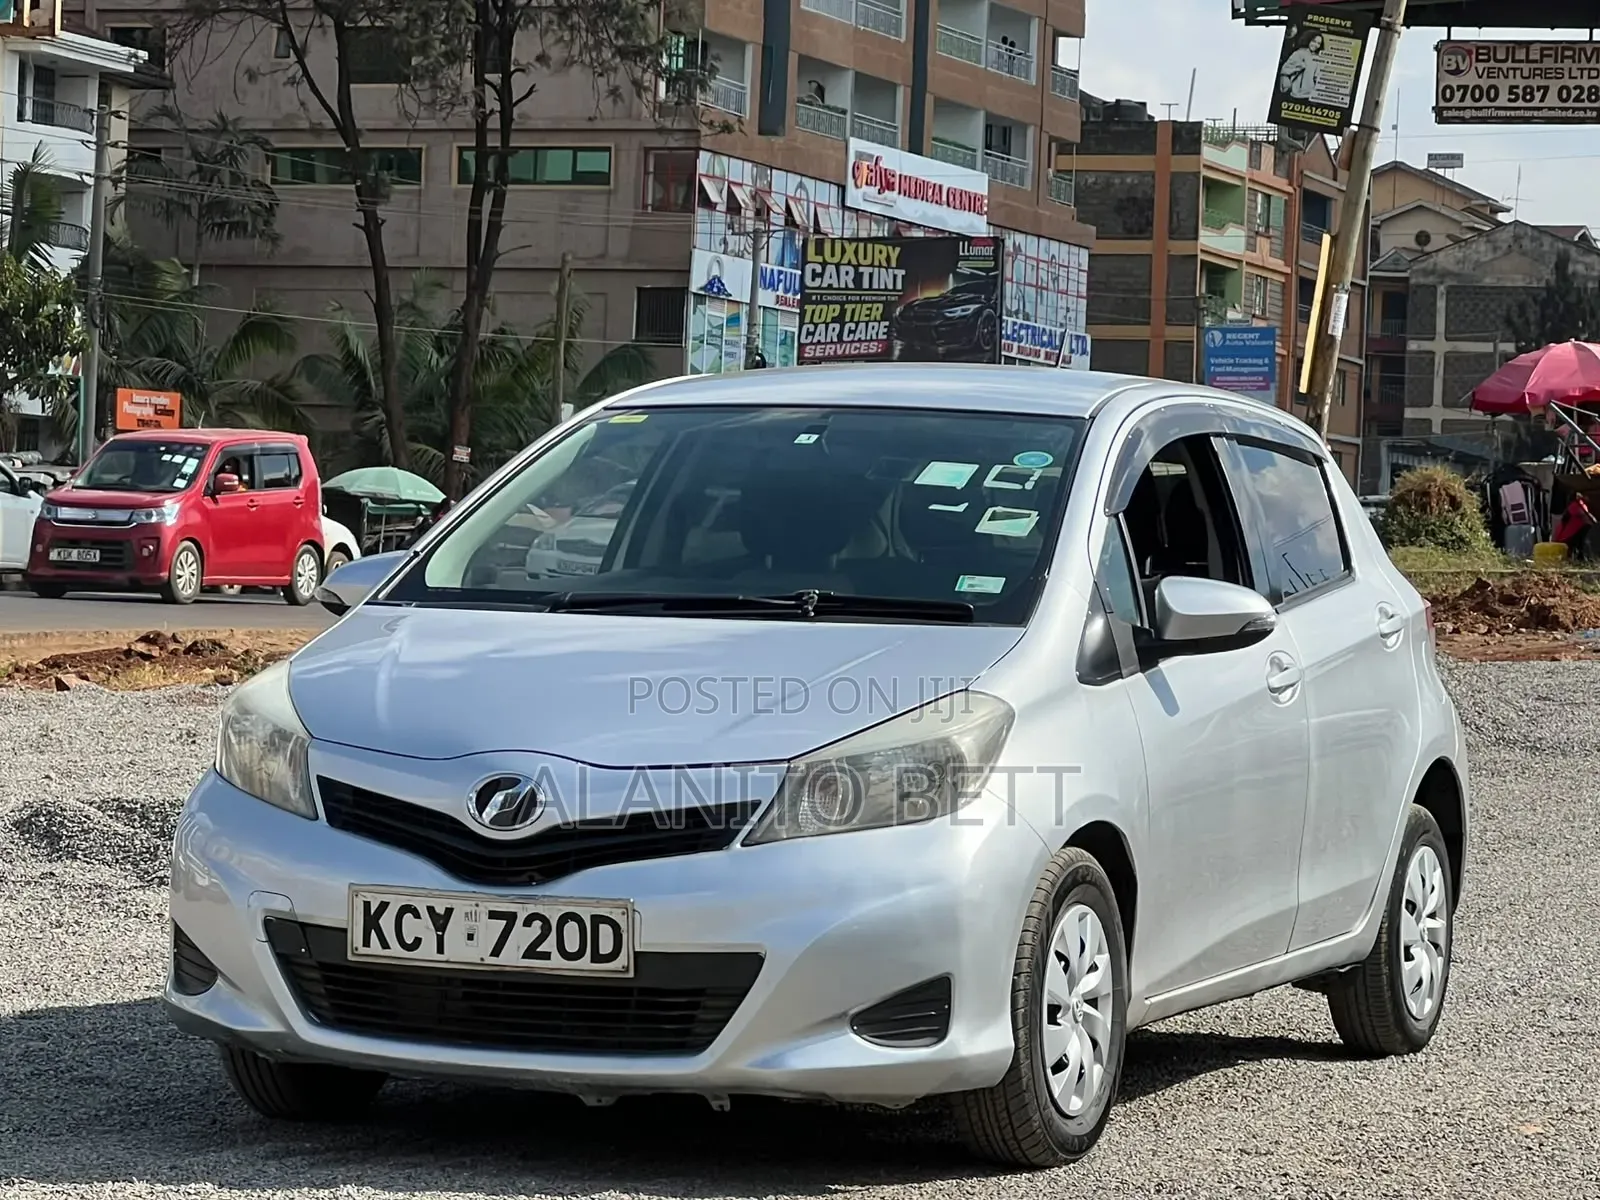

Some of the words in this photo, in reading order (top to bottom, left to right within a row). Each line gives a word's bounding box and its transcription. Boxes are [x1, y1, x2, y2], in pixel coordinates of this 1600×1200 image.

[1307, 14, 1352, 27] PROSERVE
[1475, 46, 1600, 64] BULLFIRM
[1475, 67, 1565, 79] VENTURES
[1568, 67, 1600, 80] LTD
[1441, 84, 1500, 103] 0700
[1507, 84, 1550, 103] 587
[1557, 85, 1600, 103] 028
[1281, 102, 1341, 119] 0701414705
[898, 173, 946, 206] MEDICAL
[947, 187, 988, 216] CENTRE
[807, 237, 901, 267] LUXURY
[959, 241, 994, 256] LLumar
[804, 263, 855, 288] CAR
[859, 267, 905, 290] TINT
[804, 304, 841, 323] TOP
[844, 303, 884, 322] TIER
[800, 323, 841, 343] CAR
[842, 321, 890, 342] CARE
[804, 341, 882, 357] SERVICES:
[362, 900, 455, 955] KCY
[488, 910, 623, 964] 720D
